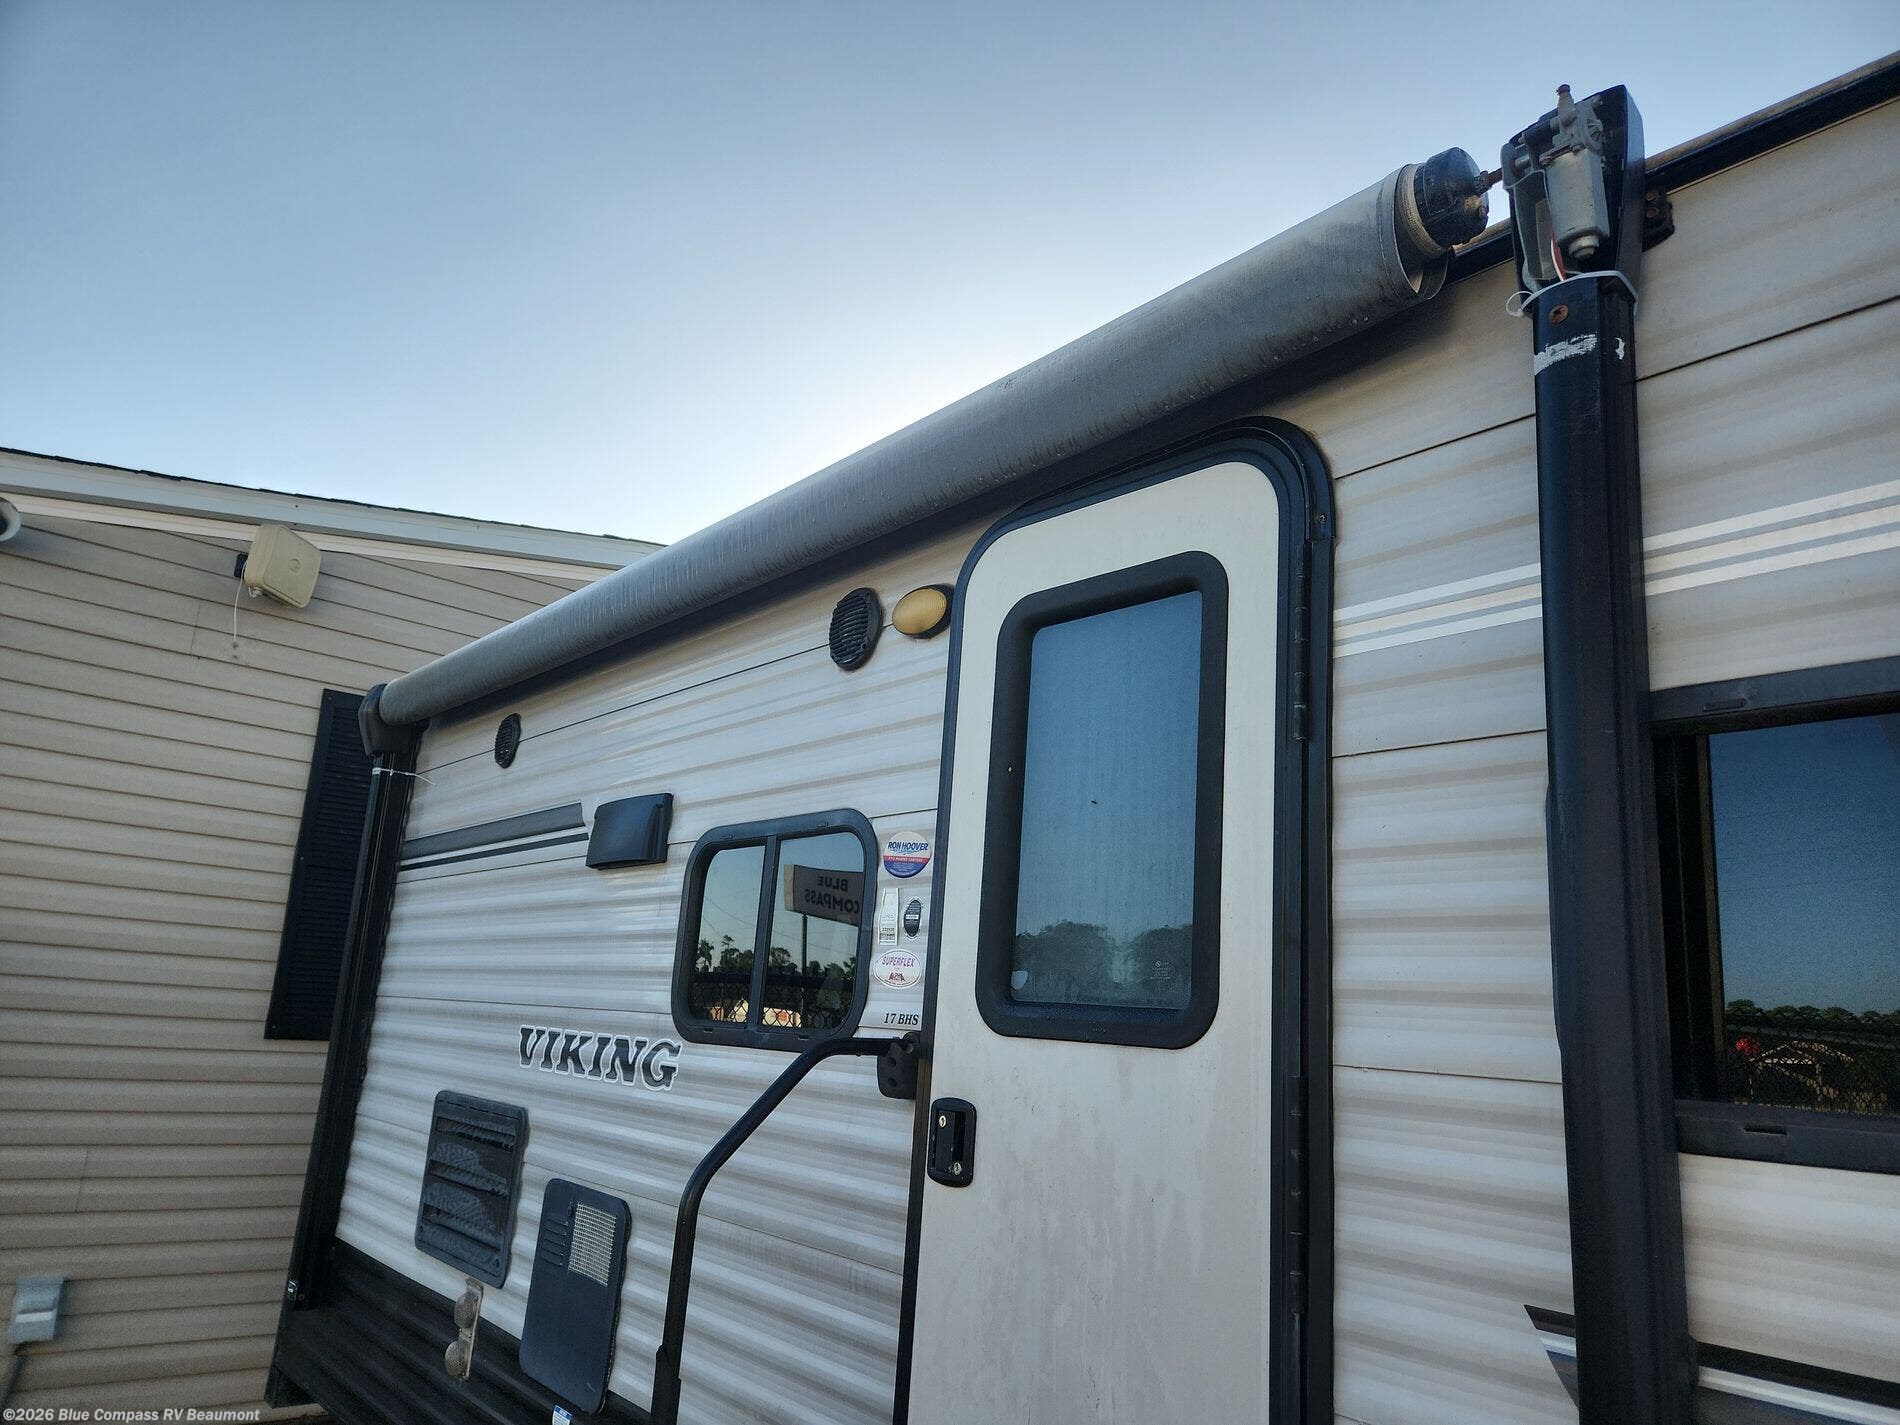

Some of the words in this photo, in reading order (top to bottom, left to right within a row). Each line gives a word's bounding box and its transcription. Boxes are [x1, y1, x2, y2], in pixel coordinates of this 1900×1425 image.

[887, 841, 901, 850] RON
[902, 842, 929, 851] HOOVER
[881, 956, 916, 968] SUPERFLEX
[884, 1012, 897, 1024] 17
[897, 1013, 920, 1026] BHS
[519, 1024, 682, 1092] VIKING
